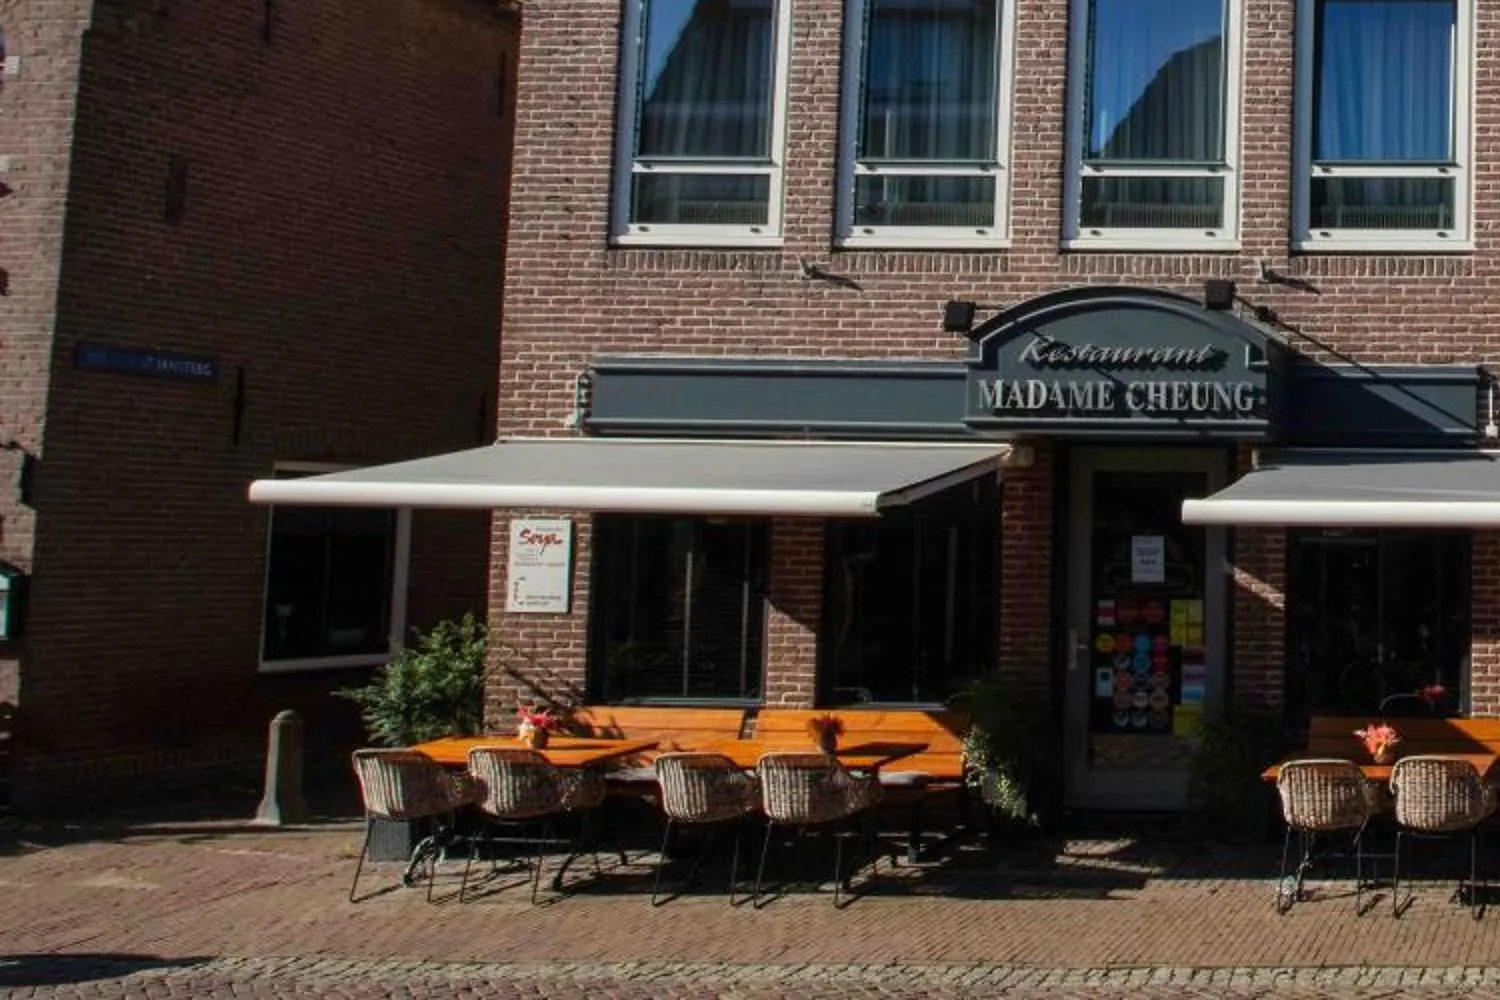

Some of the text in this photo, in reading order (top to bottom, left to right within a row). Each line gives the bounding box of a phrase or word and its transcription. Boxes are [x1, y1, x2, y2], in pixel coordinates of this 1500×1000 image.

[1018, 335, 1217, 365] Restaurant
[975, 379, 1254, 412] MADAME CHEUNG
